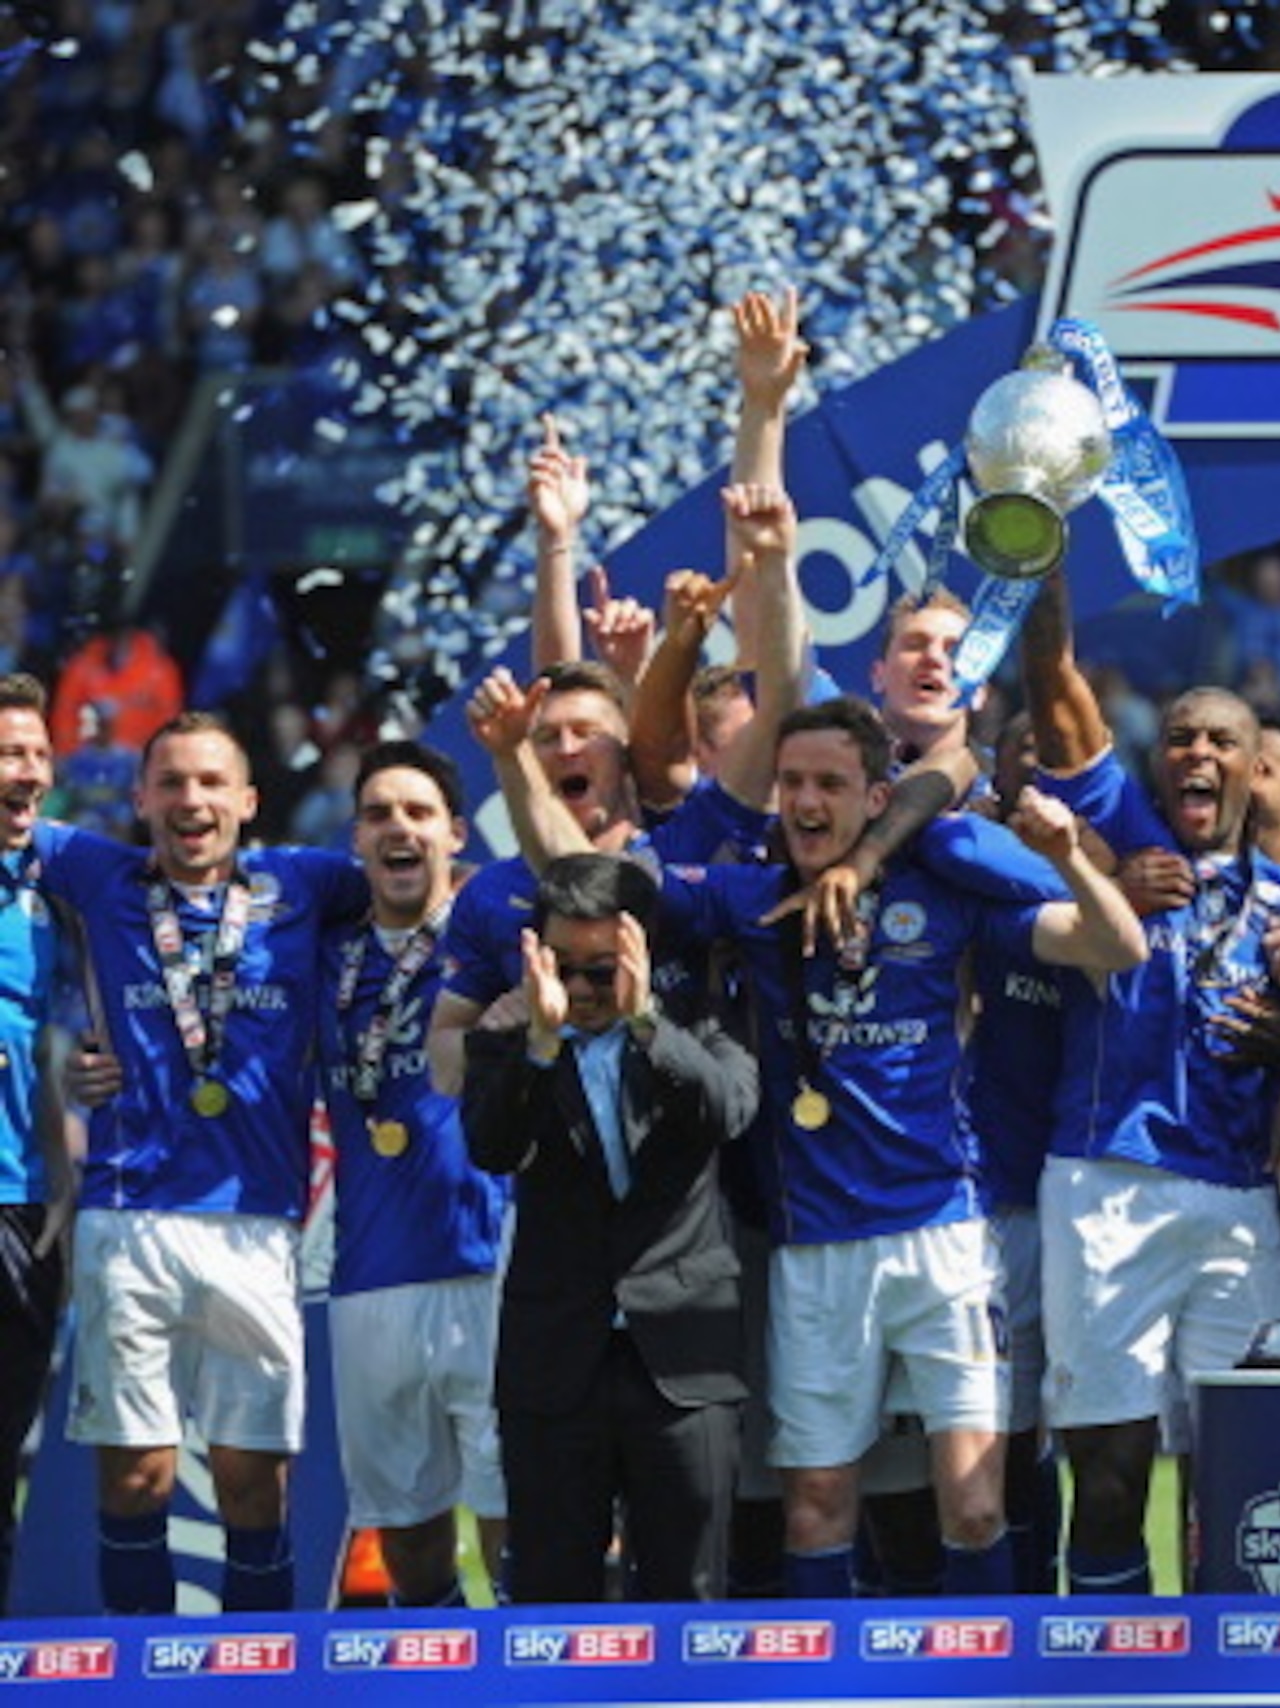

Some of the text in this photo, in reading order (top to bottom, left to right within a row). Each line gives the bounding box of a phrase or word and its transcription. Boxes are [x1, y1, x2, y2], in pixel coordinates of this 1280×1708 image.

[1005, 972, 1061, 1010] KIN
[334, 1633, 467, 1666] sky BET
[513, 1628, 650, 1661] sky BET
[692, 1624, 823, 1659] sky BET
[870, 1620, 1000, 1654] sky BET
[1048, 1618, 1177, 1652] sky BET
[1226, 1616, 1280, 1652] sky
[36, 1646, 103, 1675] BET
[153, 1640, 288, 1672] sky BET
